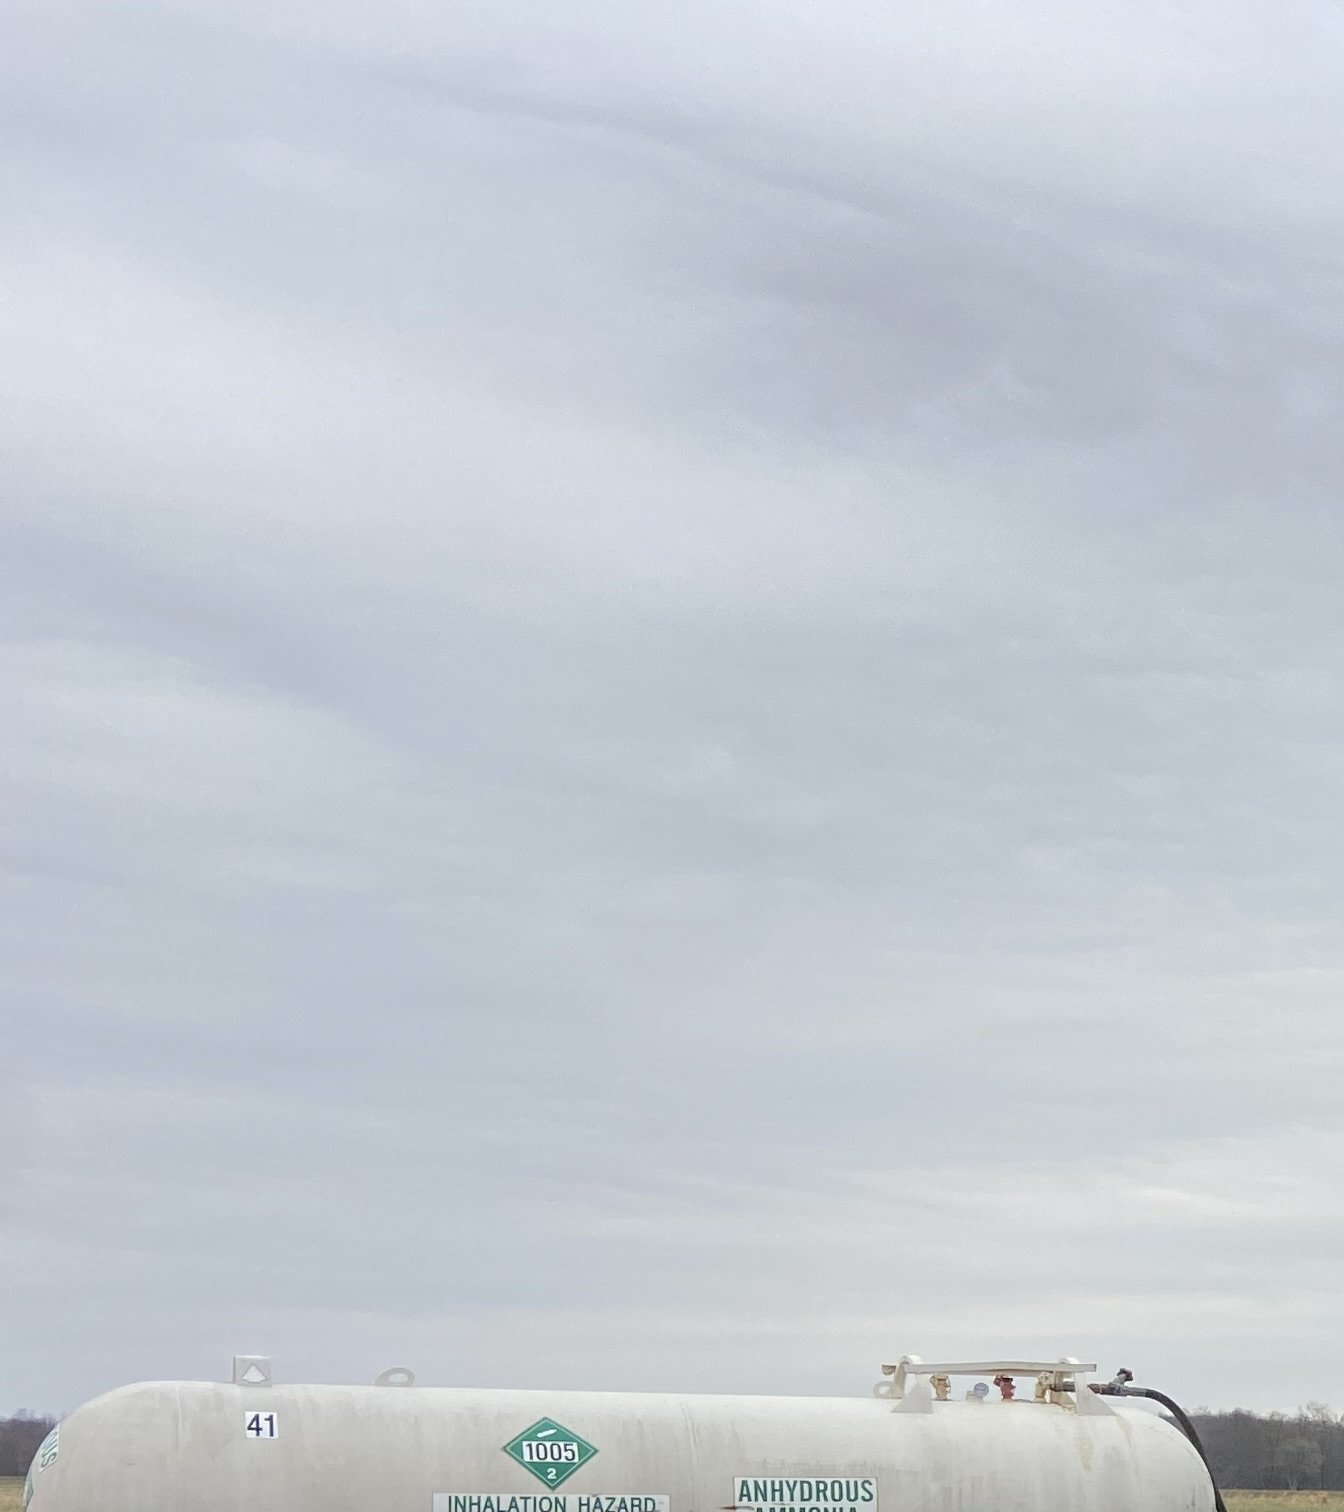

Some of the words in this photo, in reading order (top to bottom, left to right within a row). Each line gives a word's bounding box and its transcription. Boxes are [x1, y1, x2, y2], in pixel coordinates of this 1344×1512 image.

[247, 1413, 274, 1437] 41
[524, 1442, 576, 1462] 1005
[546, 1467, 557, 1480] 2
[738, 1479, 874, 1502] ANHYDROUS
